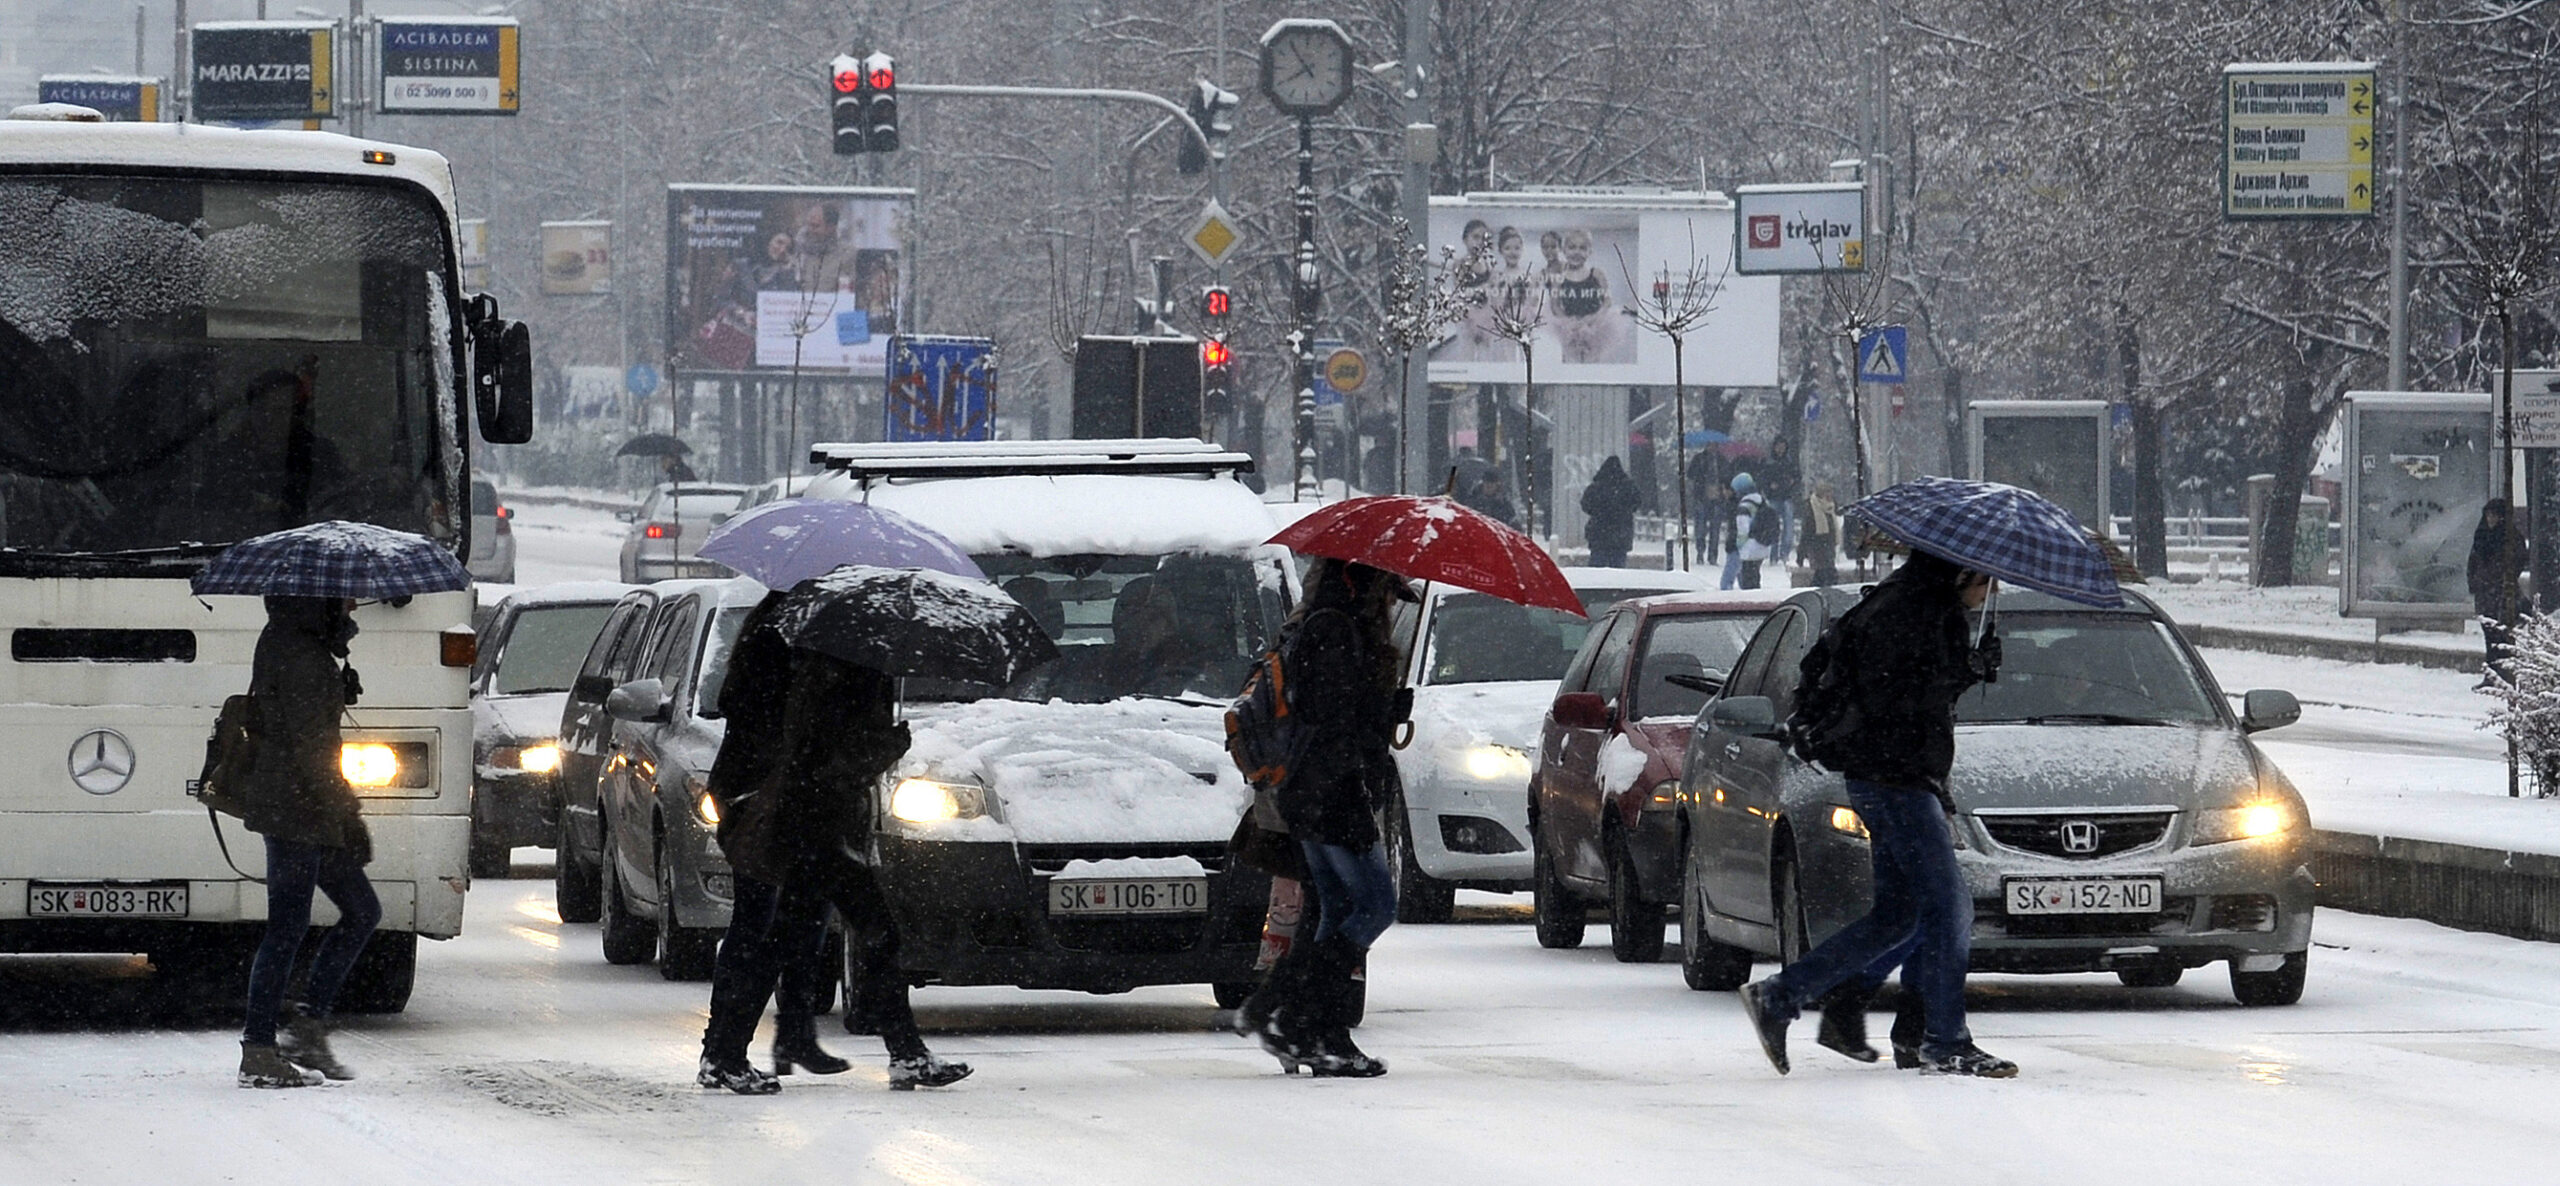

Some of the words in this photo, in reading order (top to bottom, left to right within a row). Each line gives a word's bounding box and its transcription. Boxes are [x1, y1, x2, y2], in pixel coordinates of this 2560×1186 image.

[394, 32, 489, 45] ACIBADEM
[199, 63, 292, 81] MARAZZI
[404, 57, 478, 71] SISTINA
[50, 86, 131, 100] ACIBADEM
[406, 87, 420, 98] 02
[2264, 126, 2306, 144] Болница
[2233, 147, 2267, 164] Military
[2268, 147, 2301, 163] Hospital
[2234, 172, 2277, 192] Државен
[2279, 171, 2310, 192] Архив
[2233, 195, 2263, 209] National
[2264, 195, 2296, 209] Archives
[2297, 195, 2305, 209] of
[2306, 195, 2345, 209] Macedonia
[1785, 218, 1852, 244] triglav
[1209, 292, 1228, 315] 21
[41, 891, 69, 913] SK
[90, 891, 176, 913] 083-RK
[1060, 885, 1089, 909] SK
[1113, 882, 1197, 909] 106-TO
[2017, 885, 2046, 909] SK
[2069, 883, 2152, 909] 152-ND
